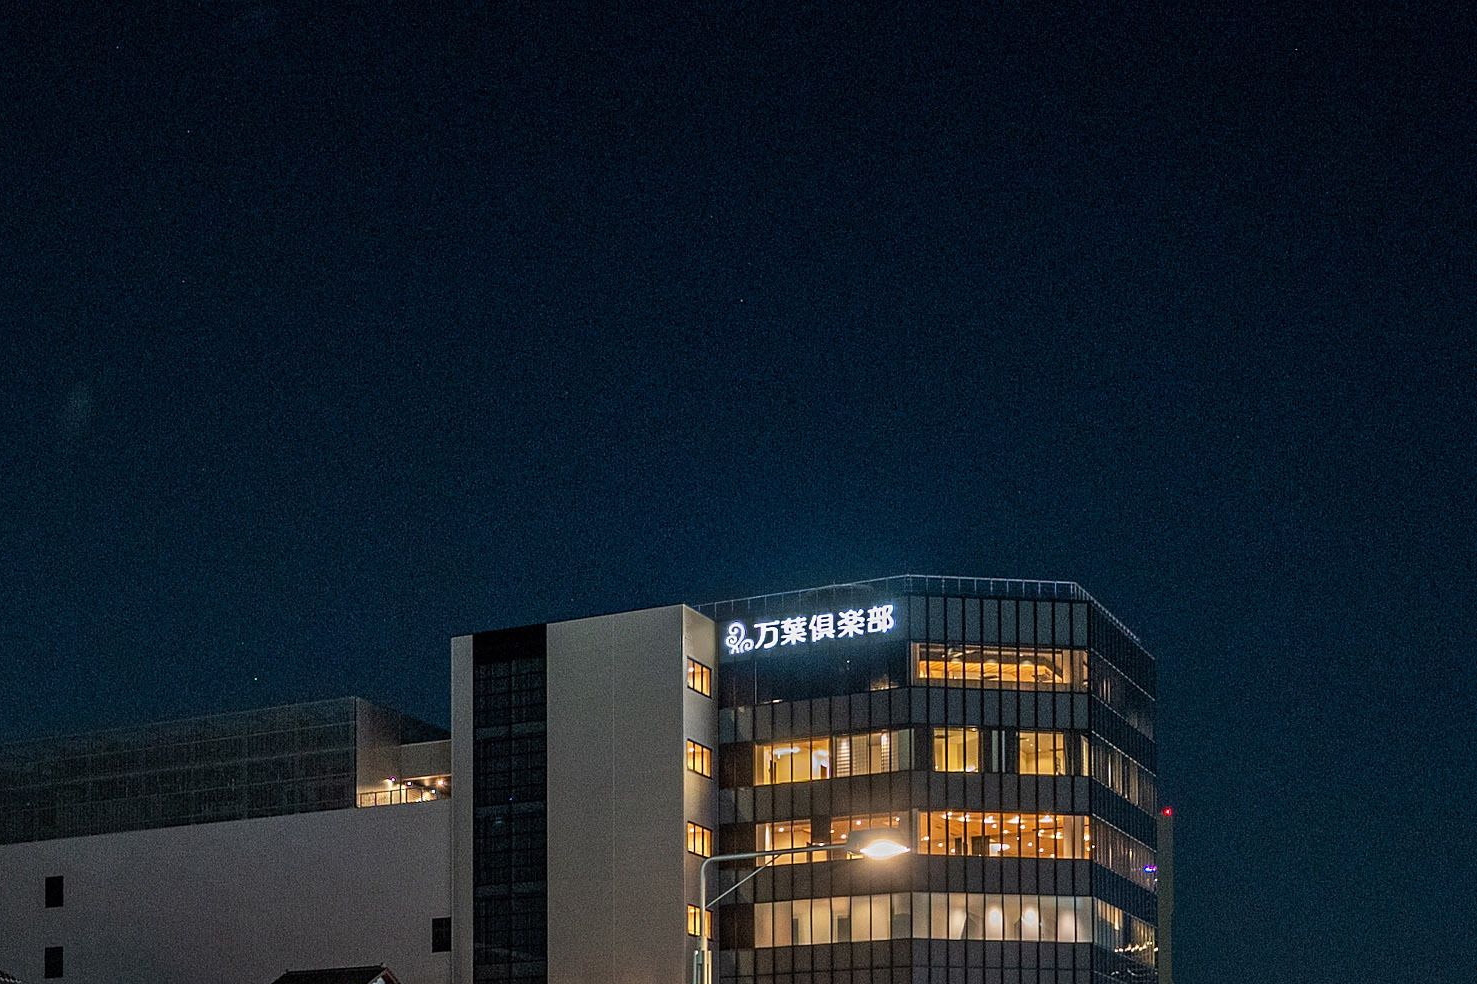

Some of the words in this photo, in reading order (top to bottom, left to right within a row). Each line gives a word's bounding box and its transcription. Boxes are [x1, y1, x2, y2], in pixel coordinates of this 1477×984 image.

[754, 604, 894, 649] 万葉倶楽部
